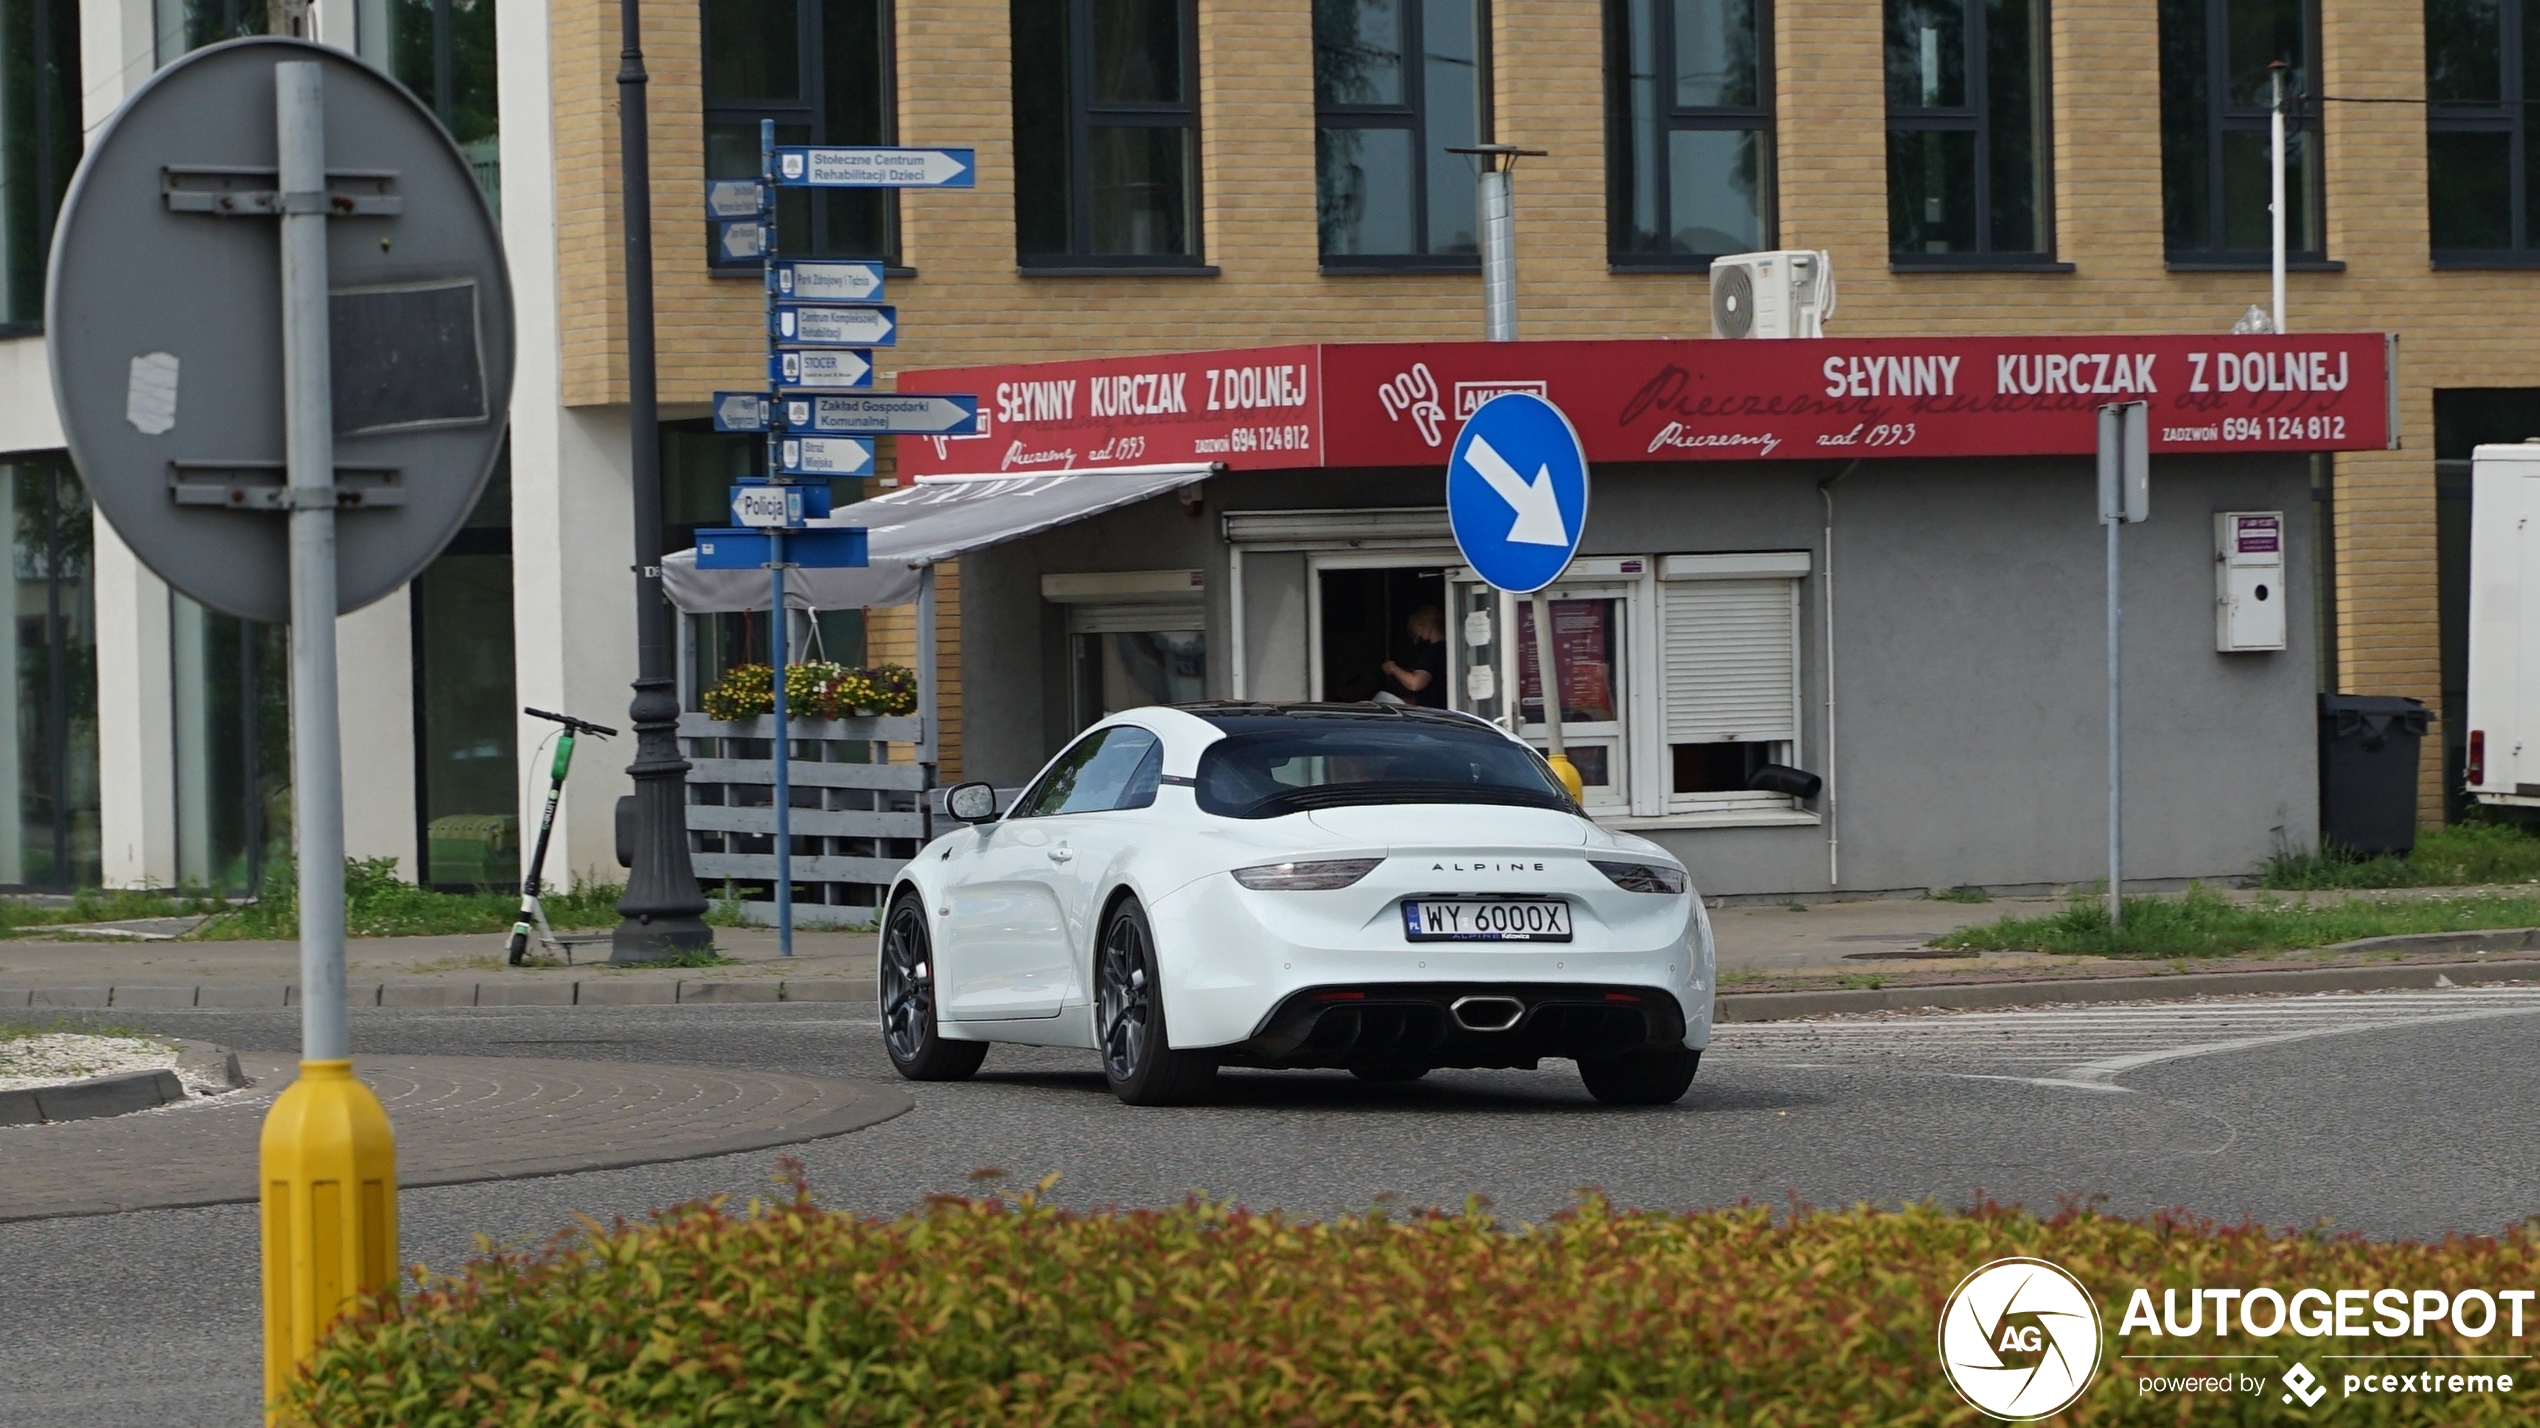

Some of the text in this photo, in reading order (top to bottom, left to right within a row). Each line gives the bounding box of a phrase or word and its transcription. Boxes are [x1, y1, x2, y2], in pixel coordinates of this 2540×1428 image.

[814, 153, 925, 166] Stołeczne Centrum
[814, 169, 925, 183] Rehabilitacji Dzieci
[797, 274, 811, 285] Park
[801, 311, 829, 322] Centrum
[804, 357, 837, 369] STOCER
[1823, 355, 1961, 398] SŁYNNY
[1997, 353, 2157, 396] KURCZAK
[2187, 352, 2210, 393] Z
[2217, 352, 2349, 393] DOLNEJ
[996, 364, 1307, 423] SŁYNNY KURCZAK Z DOLNEJ
[820, 401, 929, 415] Zakład Gospodarki
[820, 415, 889, 428] Komunalnej
[2162, 415, 2346, 442] ZADZWOŃ 694 124 812
[1231, 427, 1257, 453] 694
[1259, 426, 1283, 451] 124
[1283, 424, 1309, 450] 812
[1647, 421, 1782, 457] Pieczemy
[1864, 422, 1916, 446] 1993
[1000, 440, 1077, 471] Pieczemy
[1115, 435, 1146, 461] 1993
[745, 495, 784, 521] Policja
[1431, 863, 1544, 871] ALPINE
[1425, 905, 1562, 932] WY 6000X
[1409, 922, 1420, 930] PL
